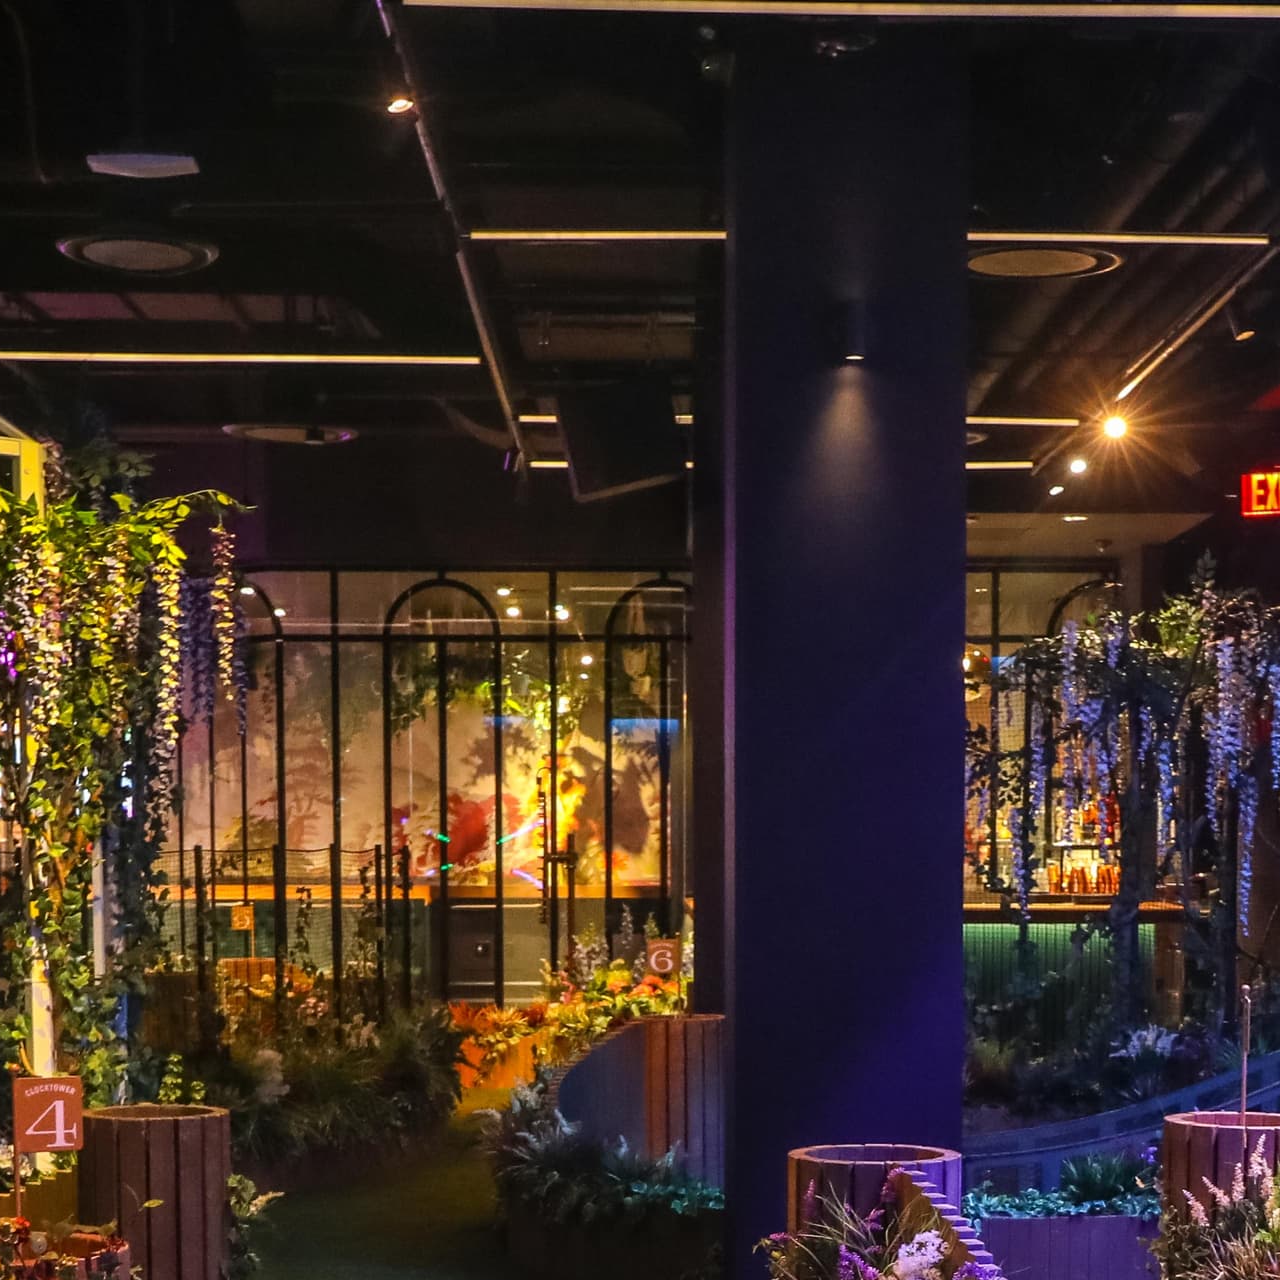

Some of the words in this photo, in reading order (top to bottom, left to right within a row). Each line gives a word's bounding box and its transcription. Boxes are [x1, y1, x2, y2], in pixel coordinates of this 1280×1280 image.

[650, 950, 674, 973] 6
[24, 1083, 76, 1097] CLOCKTOWER
[25, 1100, 77, 1148] 4
